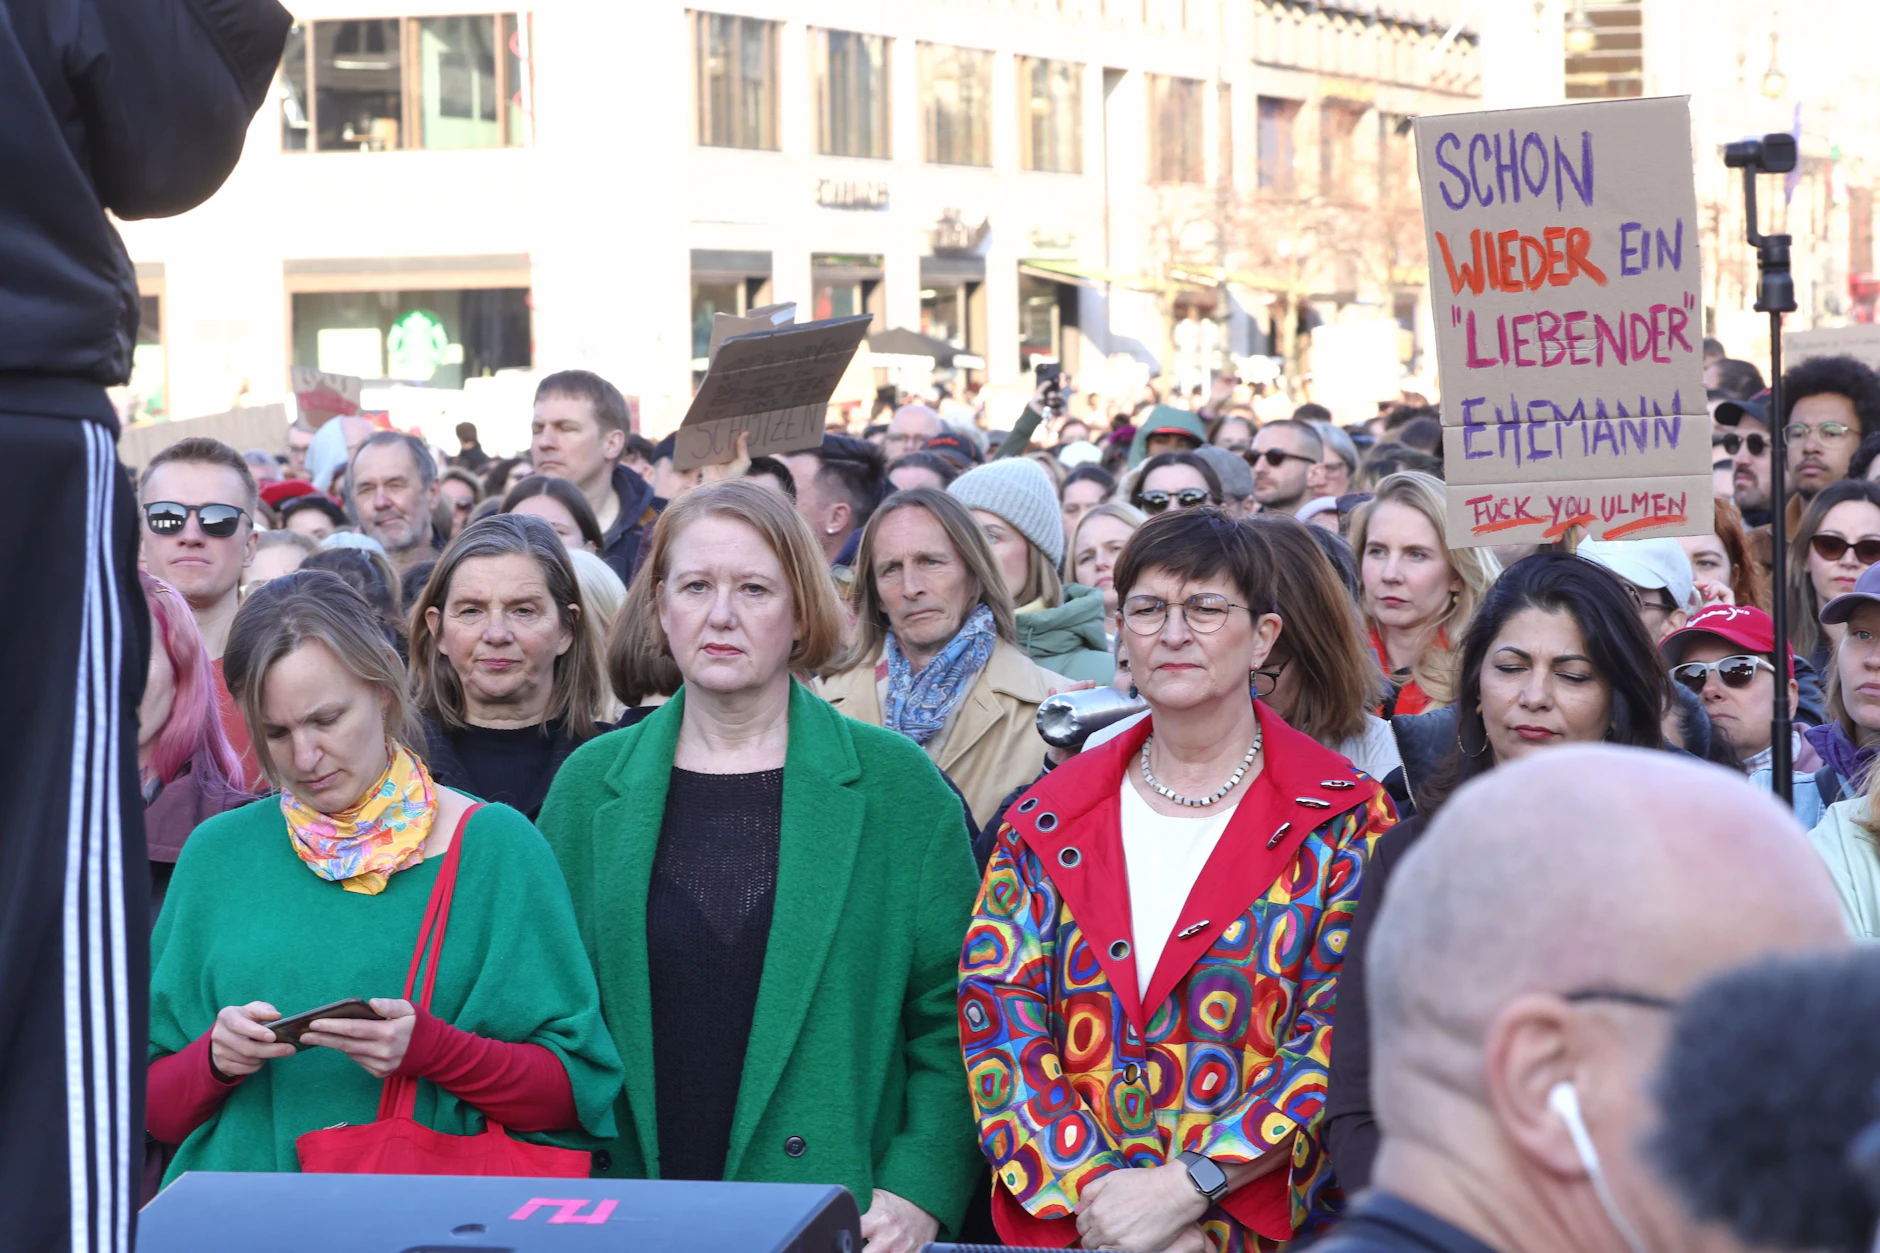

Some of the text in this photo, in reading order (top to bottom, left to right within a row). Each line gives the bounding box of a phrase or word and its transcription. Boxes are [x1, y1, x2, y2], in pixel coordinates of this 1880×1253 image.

[1435, 128, 1594, 212] SCHON
[1435, 218, 1684, 297] WIEDER EIN
[1451, 290, 1695, 369] "LIEBENDER"
[1461, 389, 1682, 469] EHEMANN
[1465, 491, 1687, 526] FUCK YOU ULMEN
